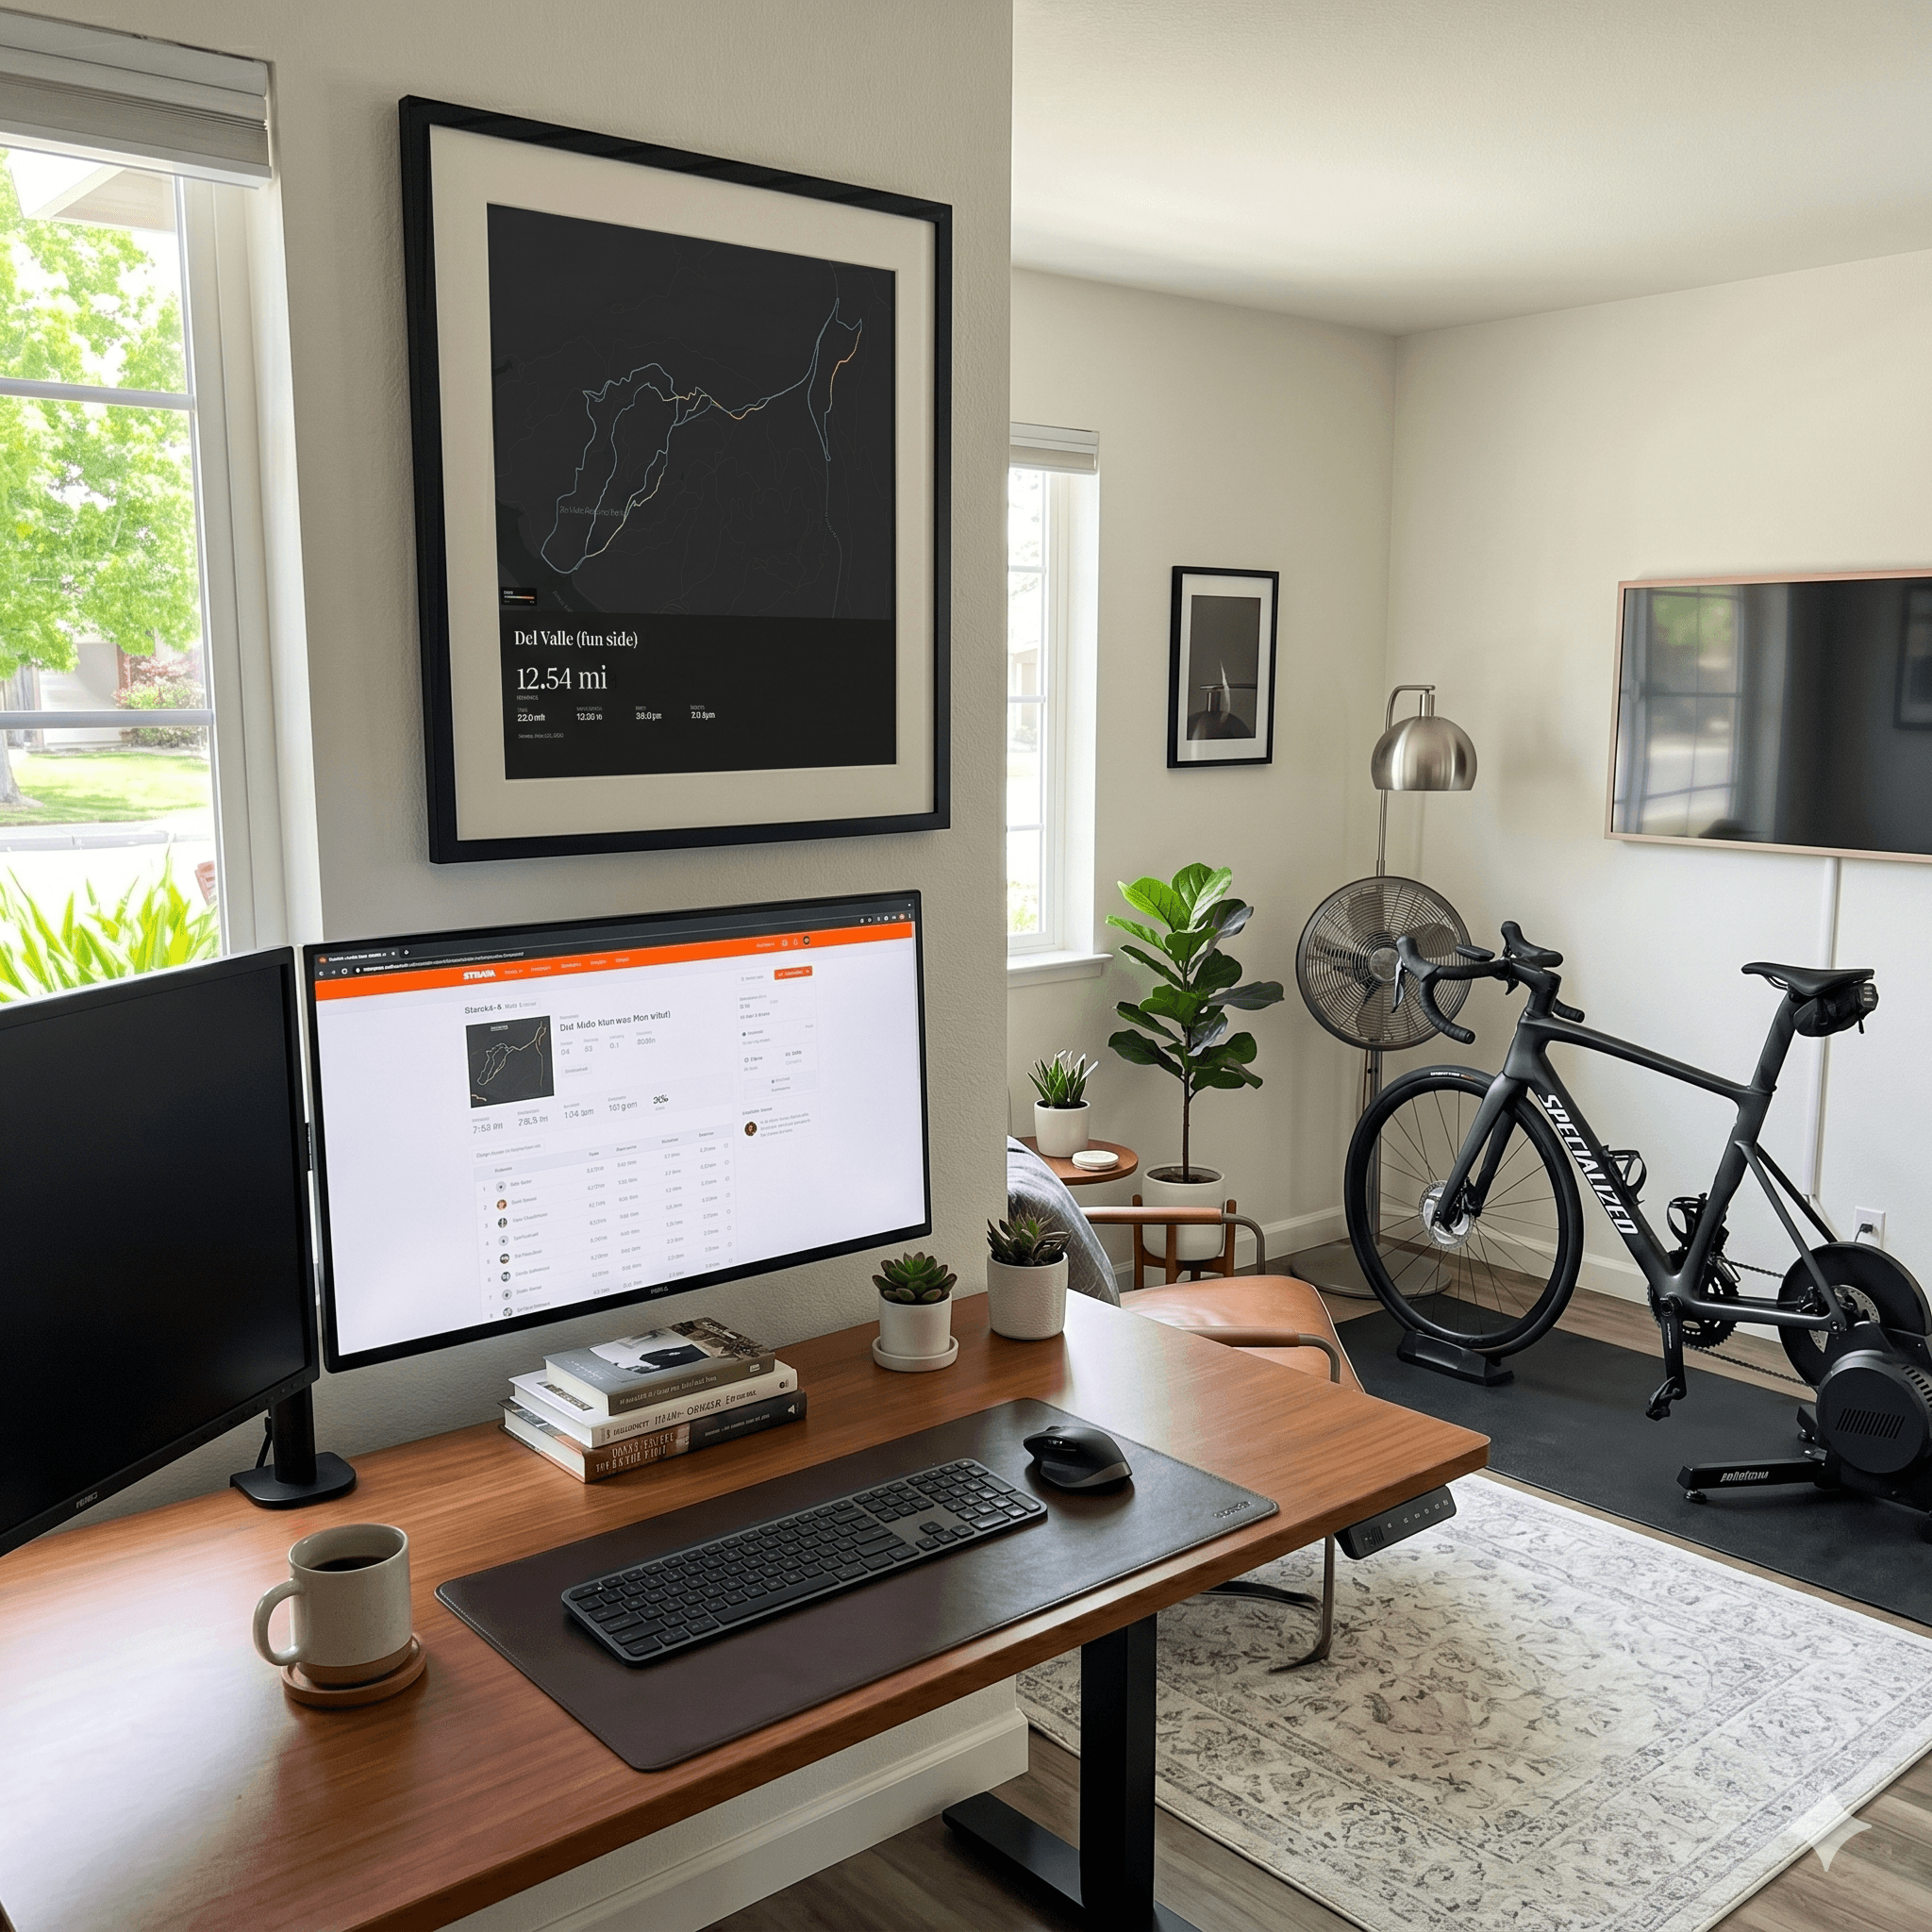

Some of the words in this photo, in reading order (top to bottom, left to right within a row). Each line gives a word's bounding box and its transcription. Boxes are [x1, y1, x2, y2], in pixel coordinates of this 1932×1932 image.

[514, 630, 538, 645] Del
[541, 630, 574, 646] Valle
[576, 630, 604, 648] (fun
[606, 630, 638, 648] side)
[517, 666, 572, 691] 12.54
[578, 665, 608, 690] mi
[1538, 1094, 1639, 1234] SPECIALIZED
